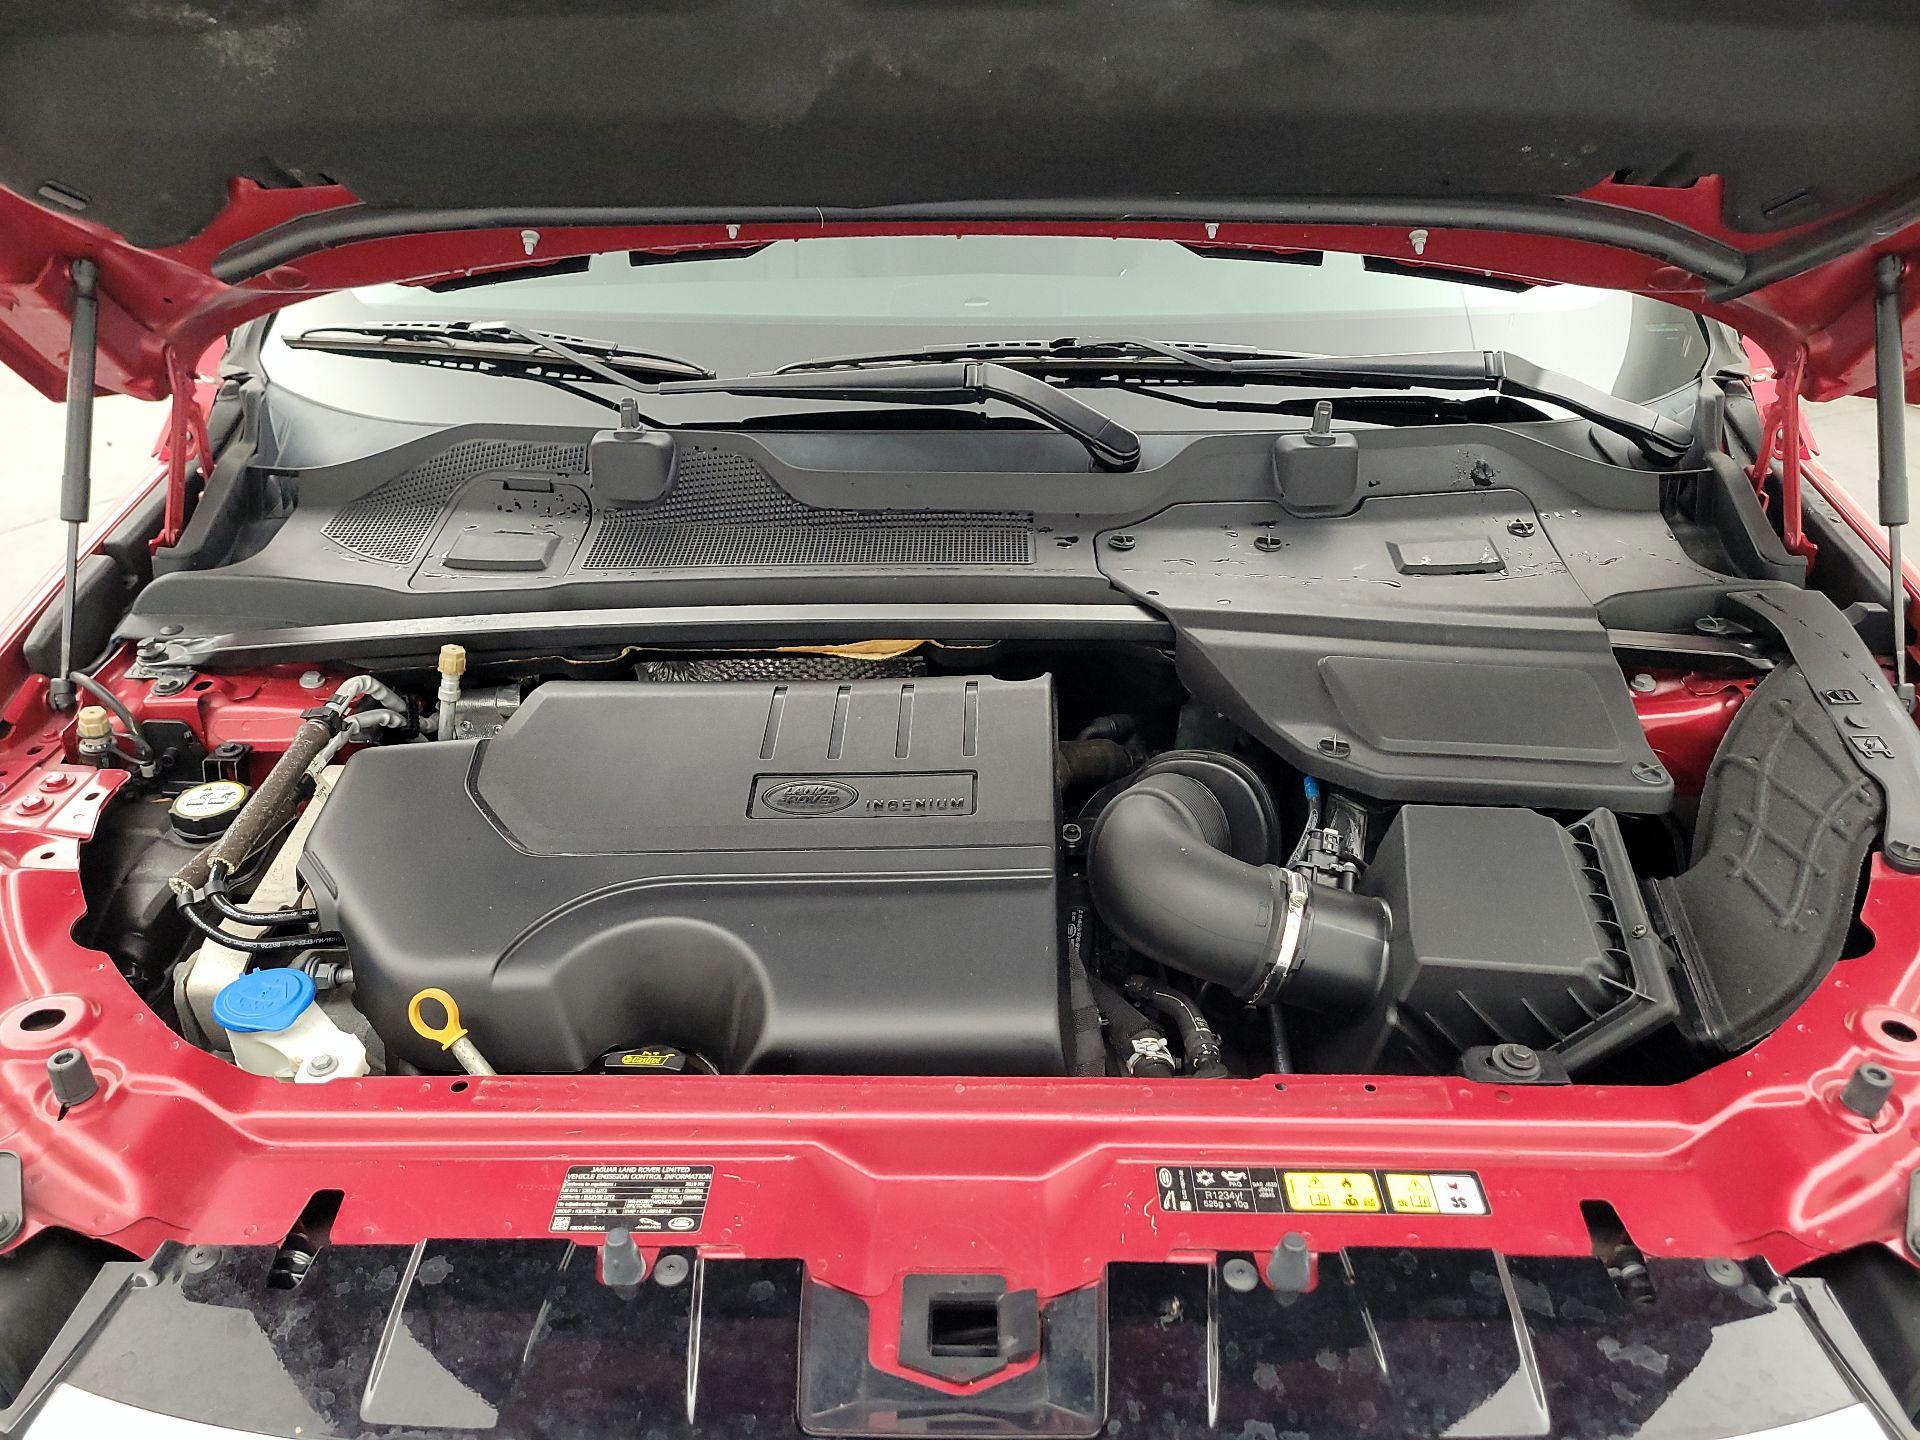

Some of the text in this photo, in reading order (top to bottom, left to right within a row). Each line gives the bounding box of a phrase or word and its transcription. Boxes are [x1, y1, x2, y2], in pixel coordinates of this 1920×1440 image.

[865, 798, 965, 812] INGENIUM
[631, 1056, 661, 1065] Castrol
[590, 1166, 691, 1174] JAGUAR LAND ROVER LIMITED
